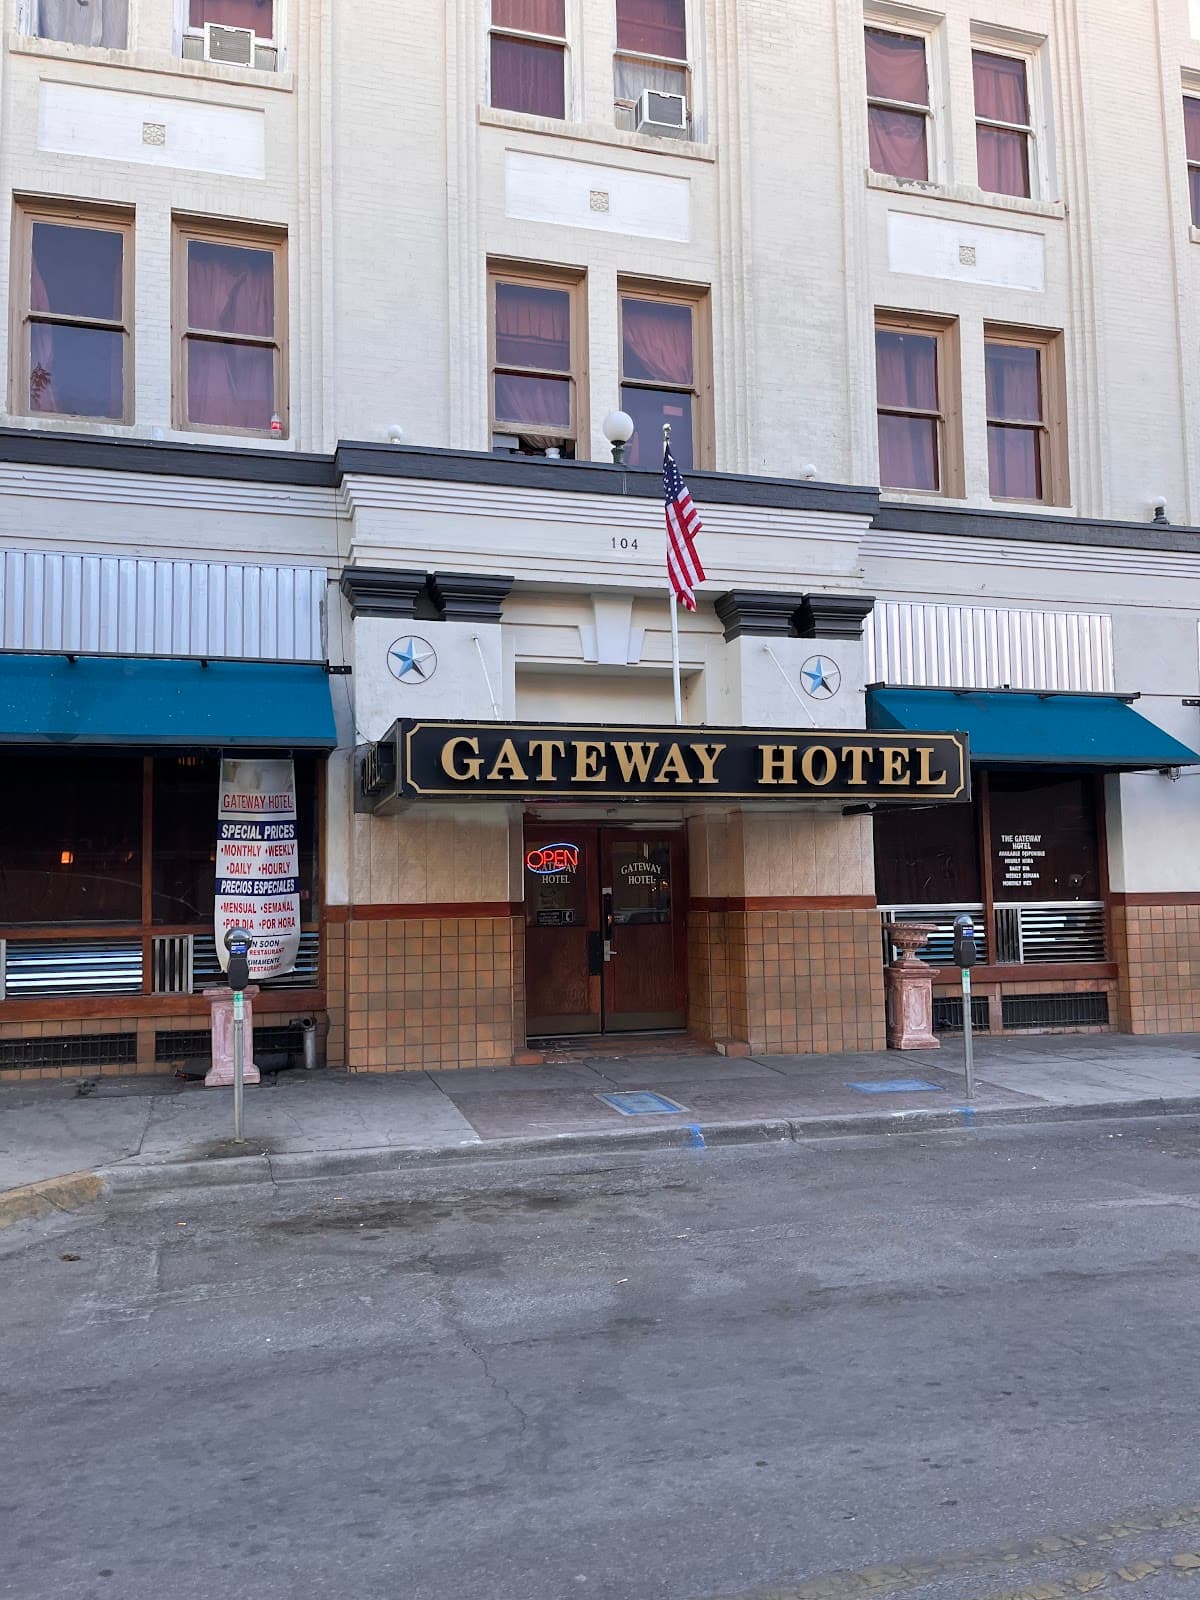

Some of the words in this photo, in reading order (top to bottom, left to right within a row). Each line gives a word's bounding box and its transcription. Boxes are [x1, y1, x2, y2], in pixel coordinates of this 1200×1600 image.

[611, 537, 638, 550] 104
[440, 736, 727, 784] GATEWAY
[758, 744, 948, 786] HOTEL
[223, 794, 266, 809] GATEWAY
[268, 794, 293, 809] HOTEL
[221, 823, 262, 840] SPECIAL
[264, 823, 295, 840] PRICES
[223, 843, 262, 857] MONTHLY
[268, 843, 295, 857] WEEKLY
[1012, 842, 1032, 850] HOTEL
[527, 849, 578, 868] OPEN
[229, 862, 252, 875] DAILY
[261, 862, 291, 875] HOURLY
[620, 862, 662, 874] GATEWAY
[220, 879, 252, 894] PRECIOS
[253, 878, 295, 894] ESPECIALES
[542, 875, 571, 884] HOTEL
[628, 875, 655, 885] HOTEL
[223, 902, 257, 914] MENSUAL
[263, 901, 294, 914] SEMANAL
[225, 918, 240, 929] POR
[261, 918, 276, 930] POR
[277, 916, 296, 929] HORA
[259, 939, 280, 948] SOON
